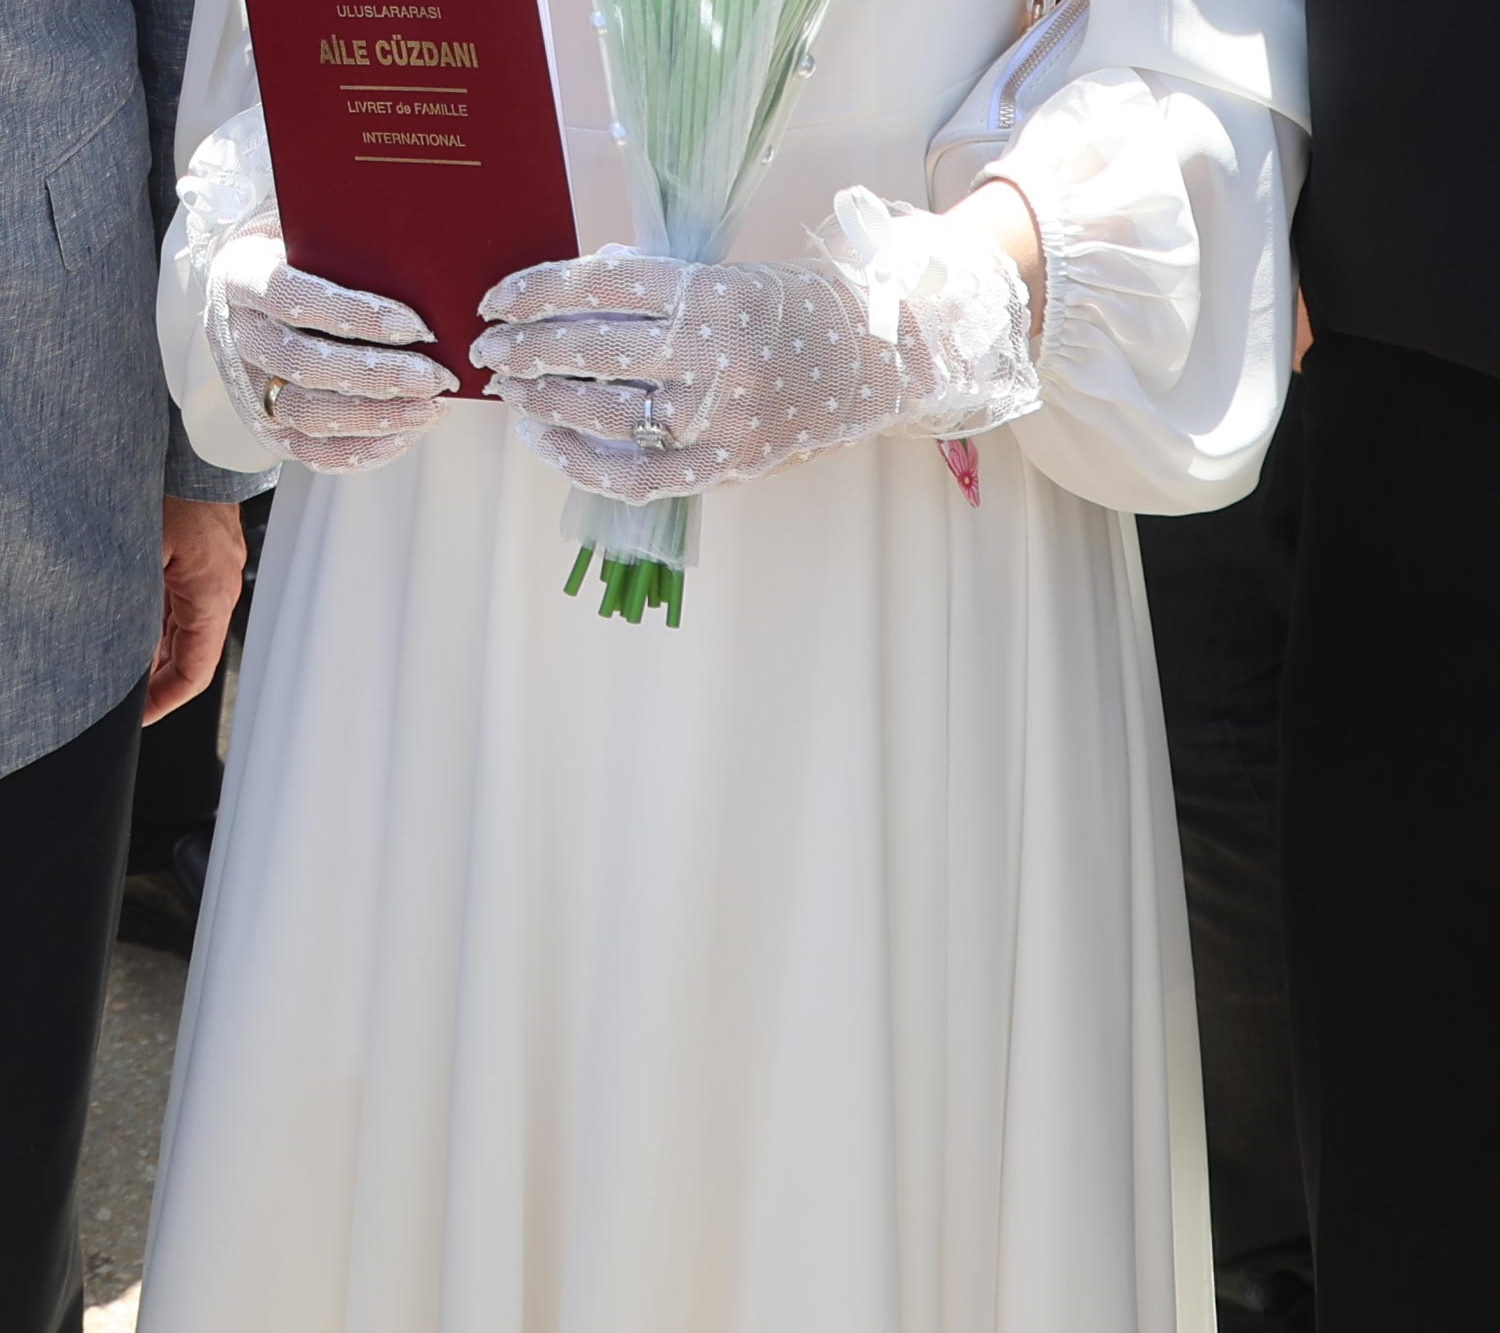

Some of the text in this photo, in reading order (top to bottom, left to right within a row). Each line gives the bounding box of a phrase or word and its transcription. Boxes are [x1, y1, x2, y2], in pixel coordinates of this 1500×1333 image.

[336, 4, 442, 20] ULUSLARARASI
[319, 33, 479, 69] AİLE CÜZDANI
[347, 100, 469, 117] LIVRET de FAMILLE
[362, 131, 466, 148] INTERNATIONAL
